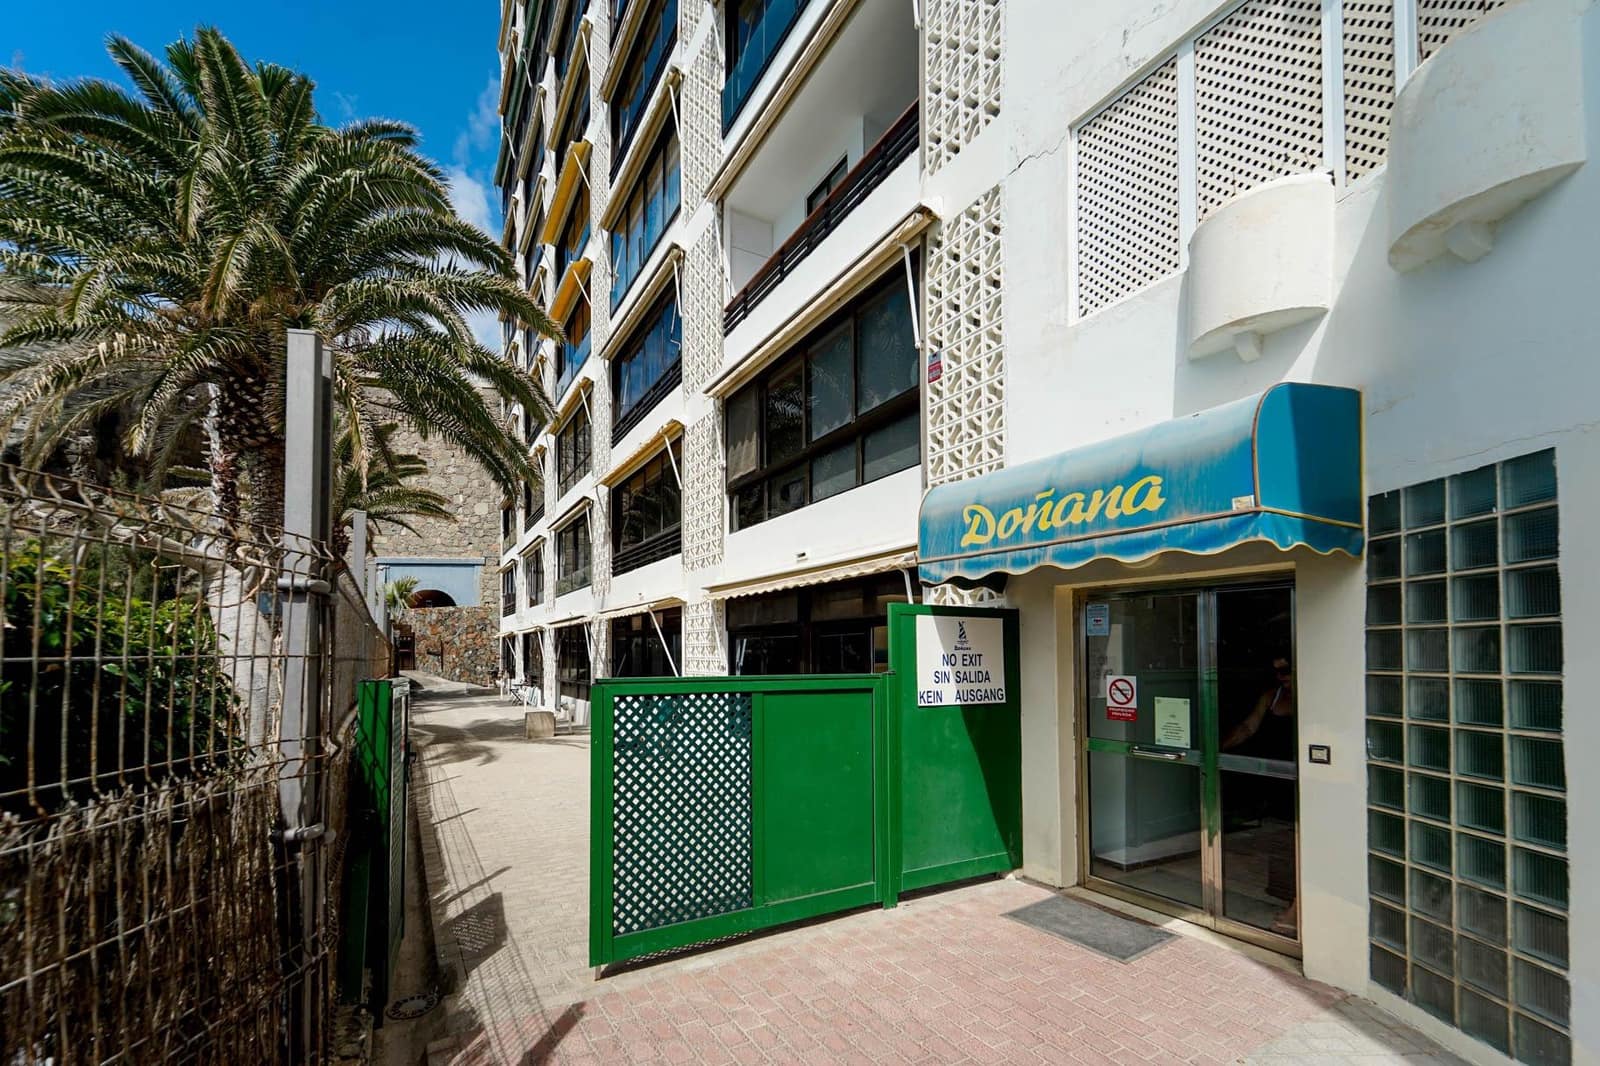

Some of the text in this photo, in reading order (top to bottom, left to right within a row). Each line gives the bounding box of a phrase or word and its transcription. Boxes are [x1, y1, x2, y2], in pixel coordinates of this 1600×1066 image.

[960, 475, 1166, 548] Doñana
[942, 653, 983, 666] NO EXIT
[934, 670, 991, 684] SIN SALIDA
[919, 688, 1004, 704] KEIN AUSGANG
